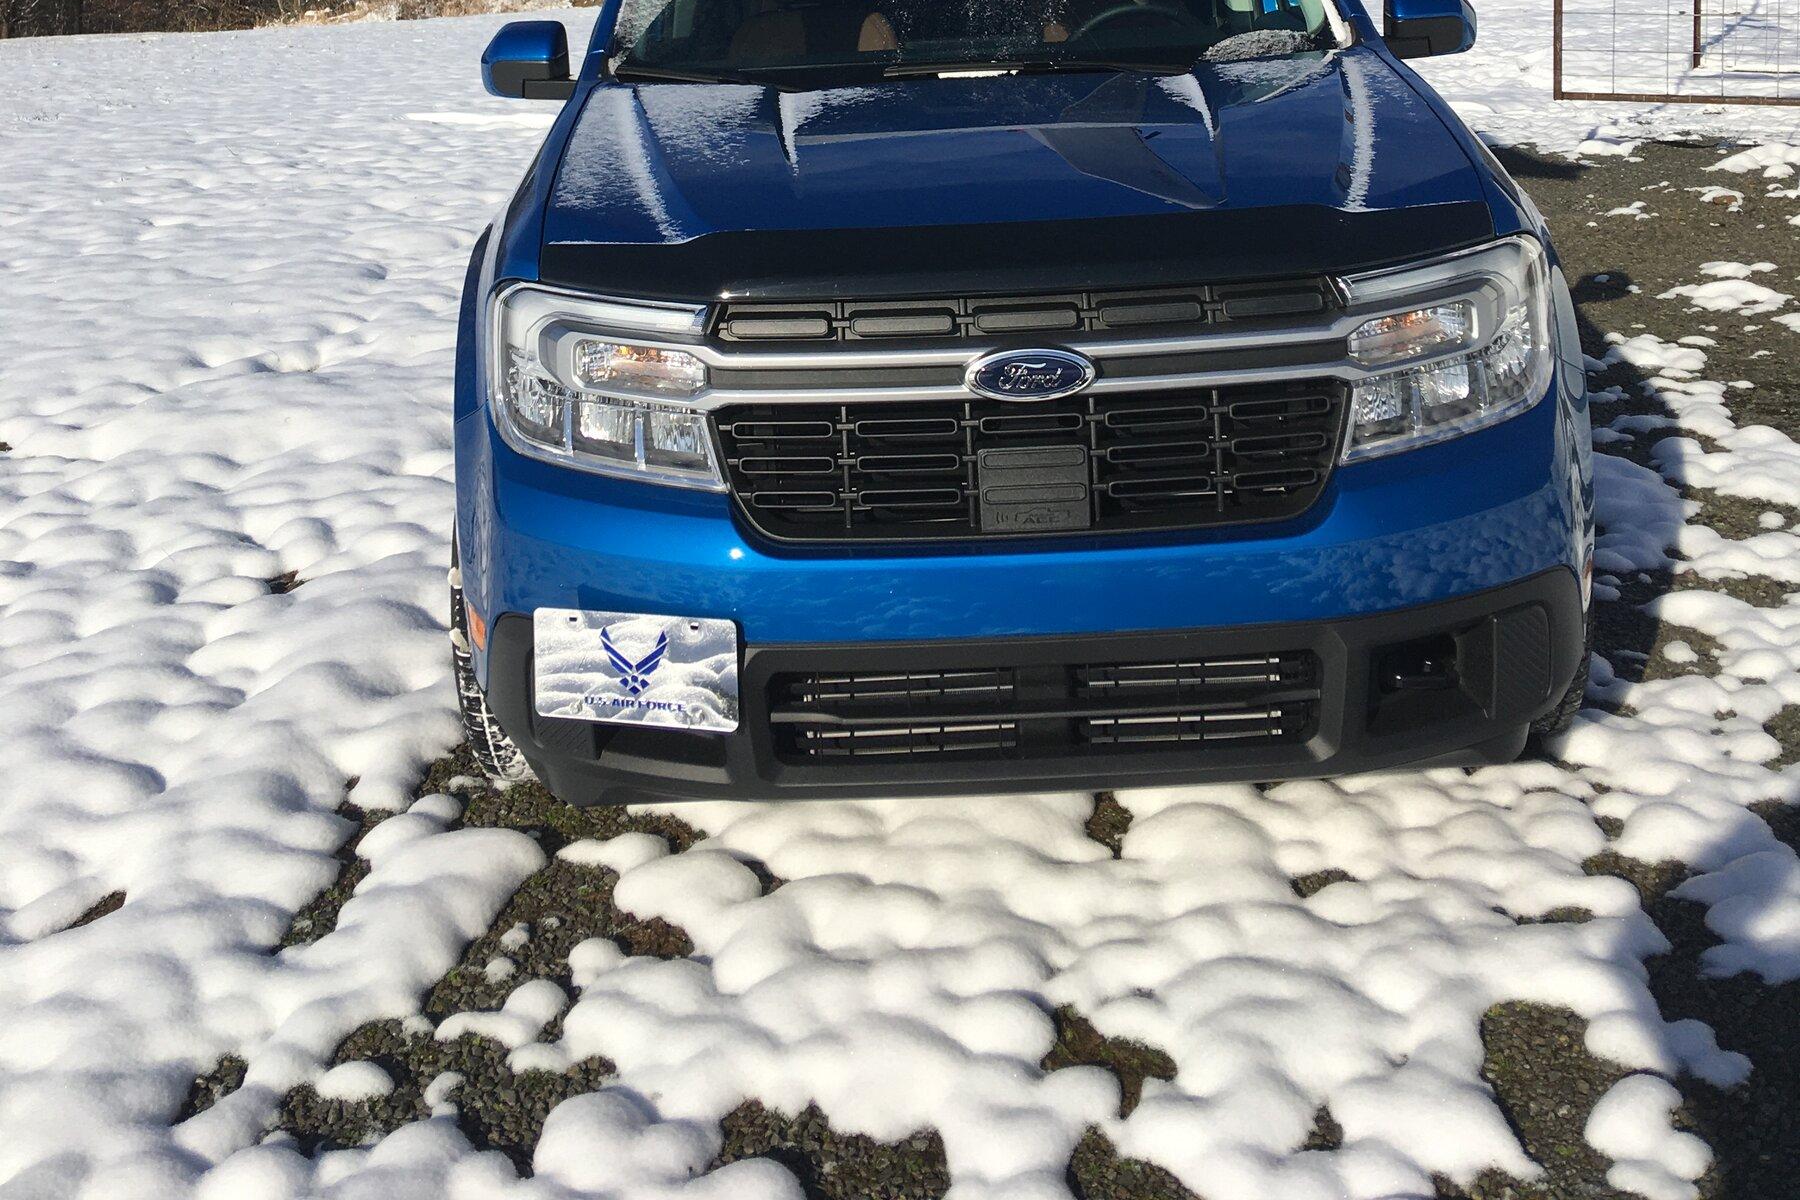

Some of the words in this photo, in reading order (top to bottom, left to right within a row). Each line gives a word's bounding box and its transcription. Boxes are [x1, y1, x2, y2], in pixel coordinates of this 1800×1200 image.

[998, 362, 1063, 390] Ford
[611, 698, 635, 709] AIR
[638, 700, 685, 712] FORCE
